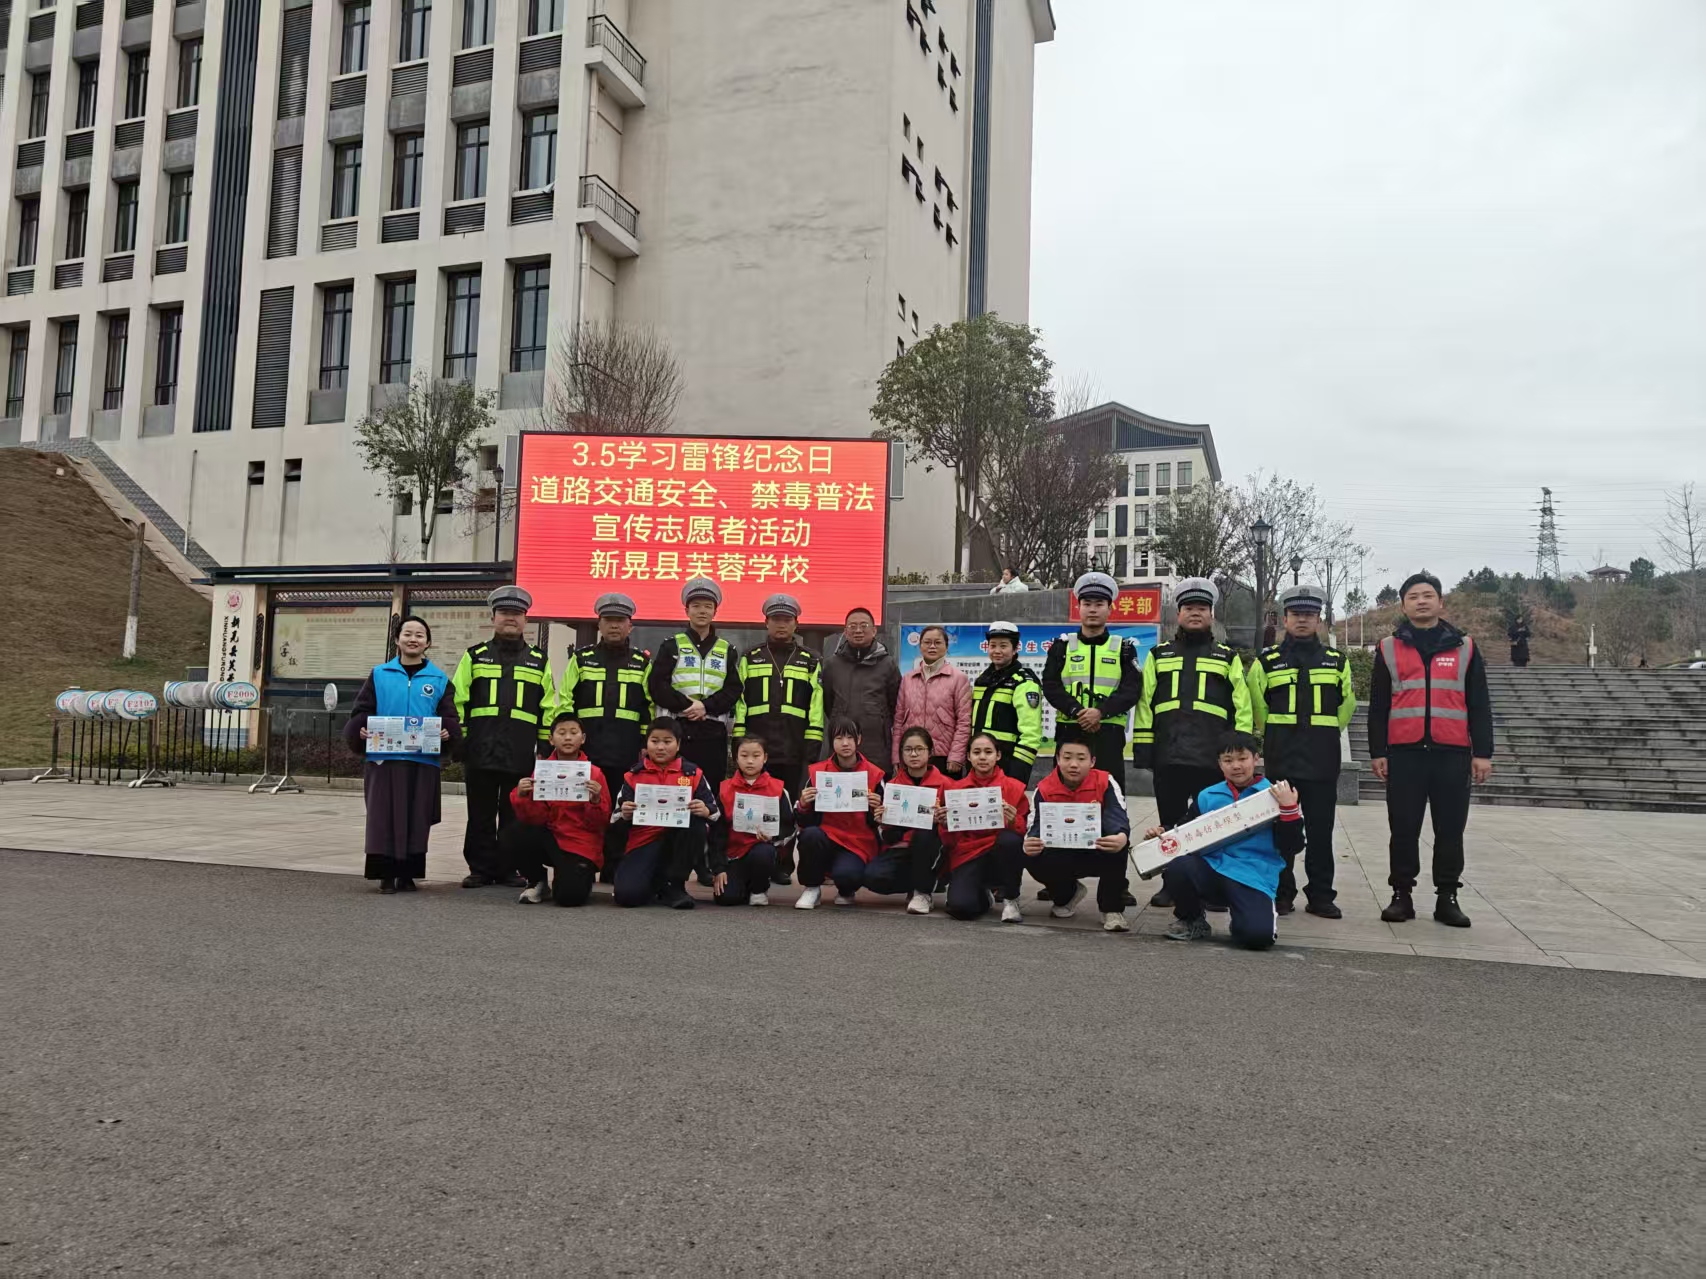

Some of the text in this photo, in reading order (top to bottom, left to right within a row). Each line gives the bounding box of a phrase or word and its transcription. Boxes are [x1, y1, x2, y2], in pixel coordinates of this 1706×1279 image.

[572, 441, 834, 475] 3.5学习雷锋纪念日
[531, 476, 876, 512] 道路交通安全、禁毒普法
[592, 513, 811, 548] 宣传志愿者活动
[590, 549, 811, 583] 新晃县芙蓉学校
[227, 690, 255, 698] F2008
